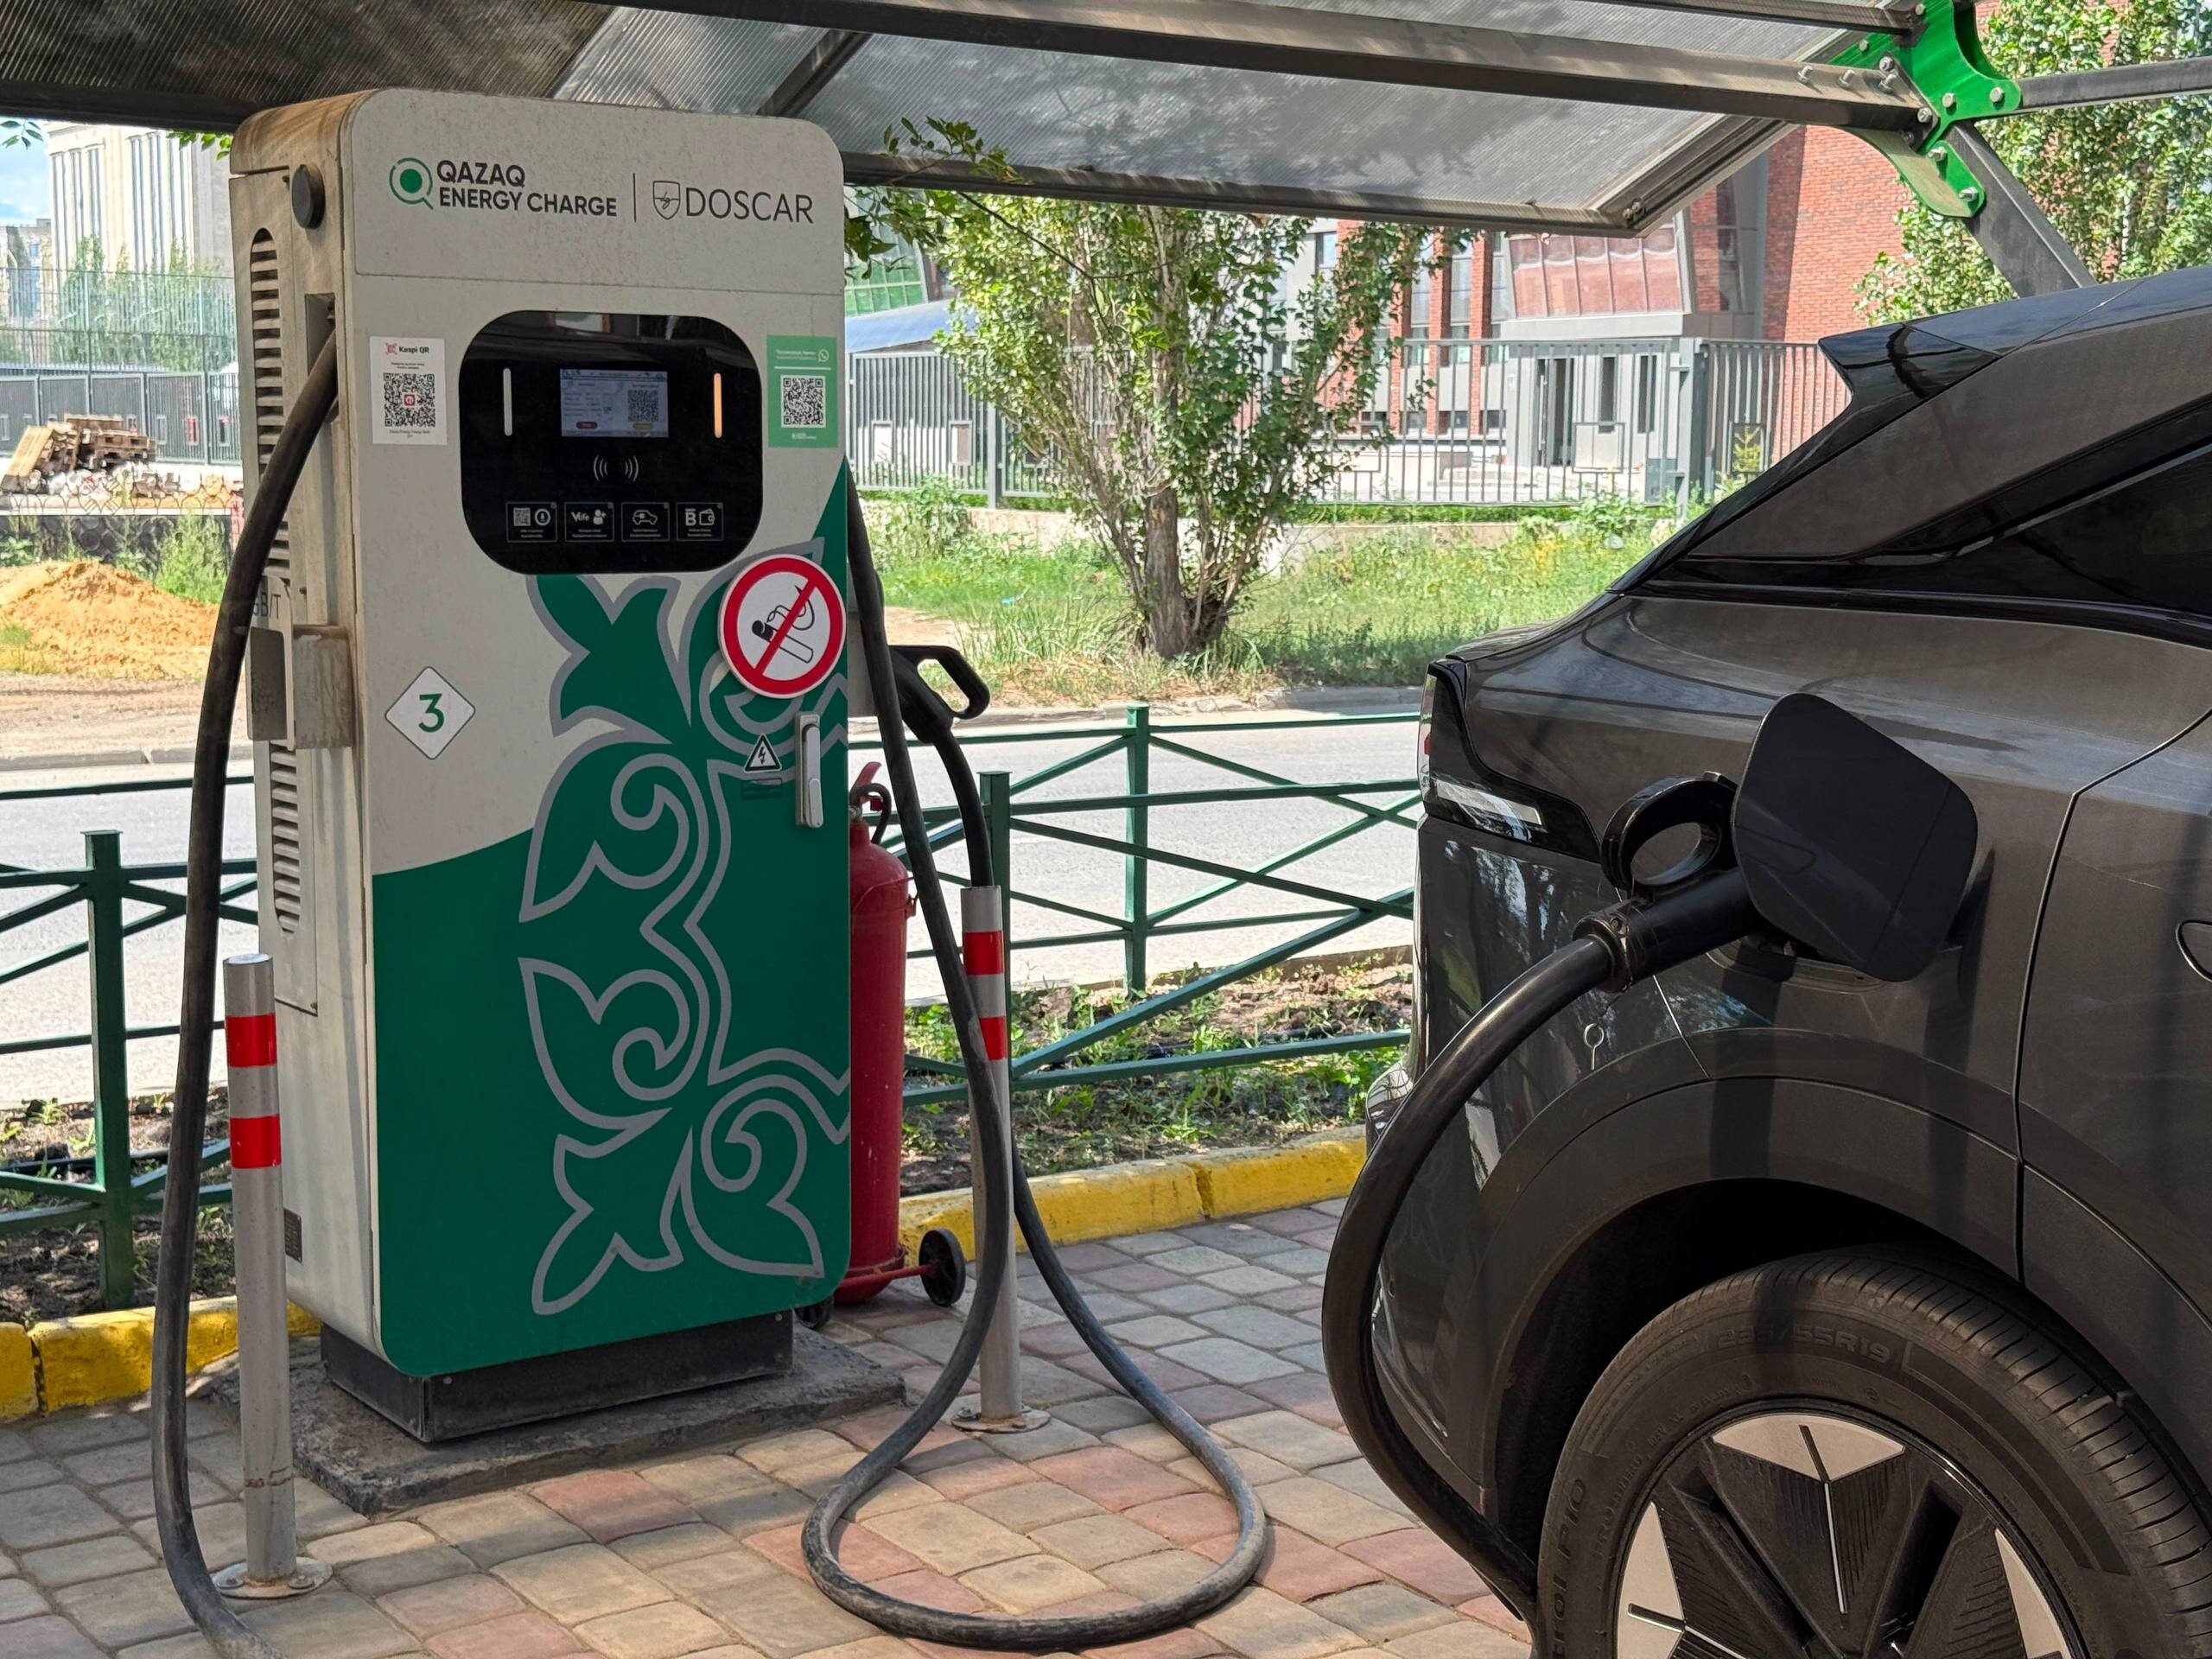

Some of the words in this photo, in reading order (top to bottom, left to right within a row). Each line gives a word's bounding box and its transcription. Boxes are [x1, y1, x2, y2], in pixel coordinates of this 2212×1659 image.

[436, 160, 526, 188] QAZAQ
[439, 187, 522, 211] ENERGY
[526, 192, 617, 217] CHARGE
[685, 187, 814, 224] DOSCAR
[398, 346, 418, 354] Kaspi
[418, 693, 445, 734] 3
